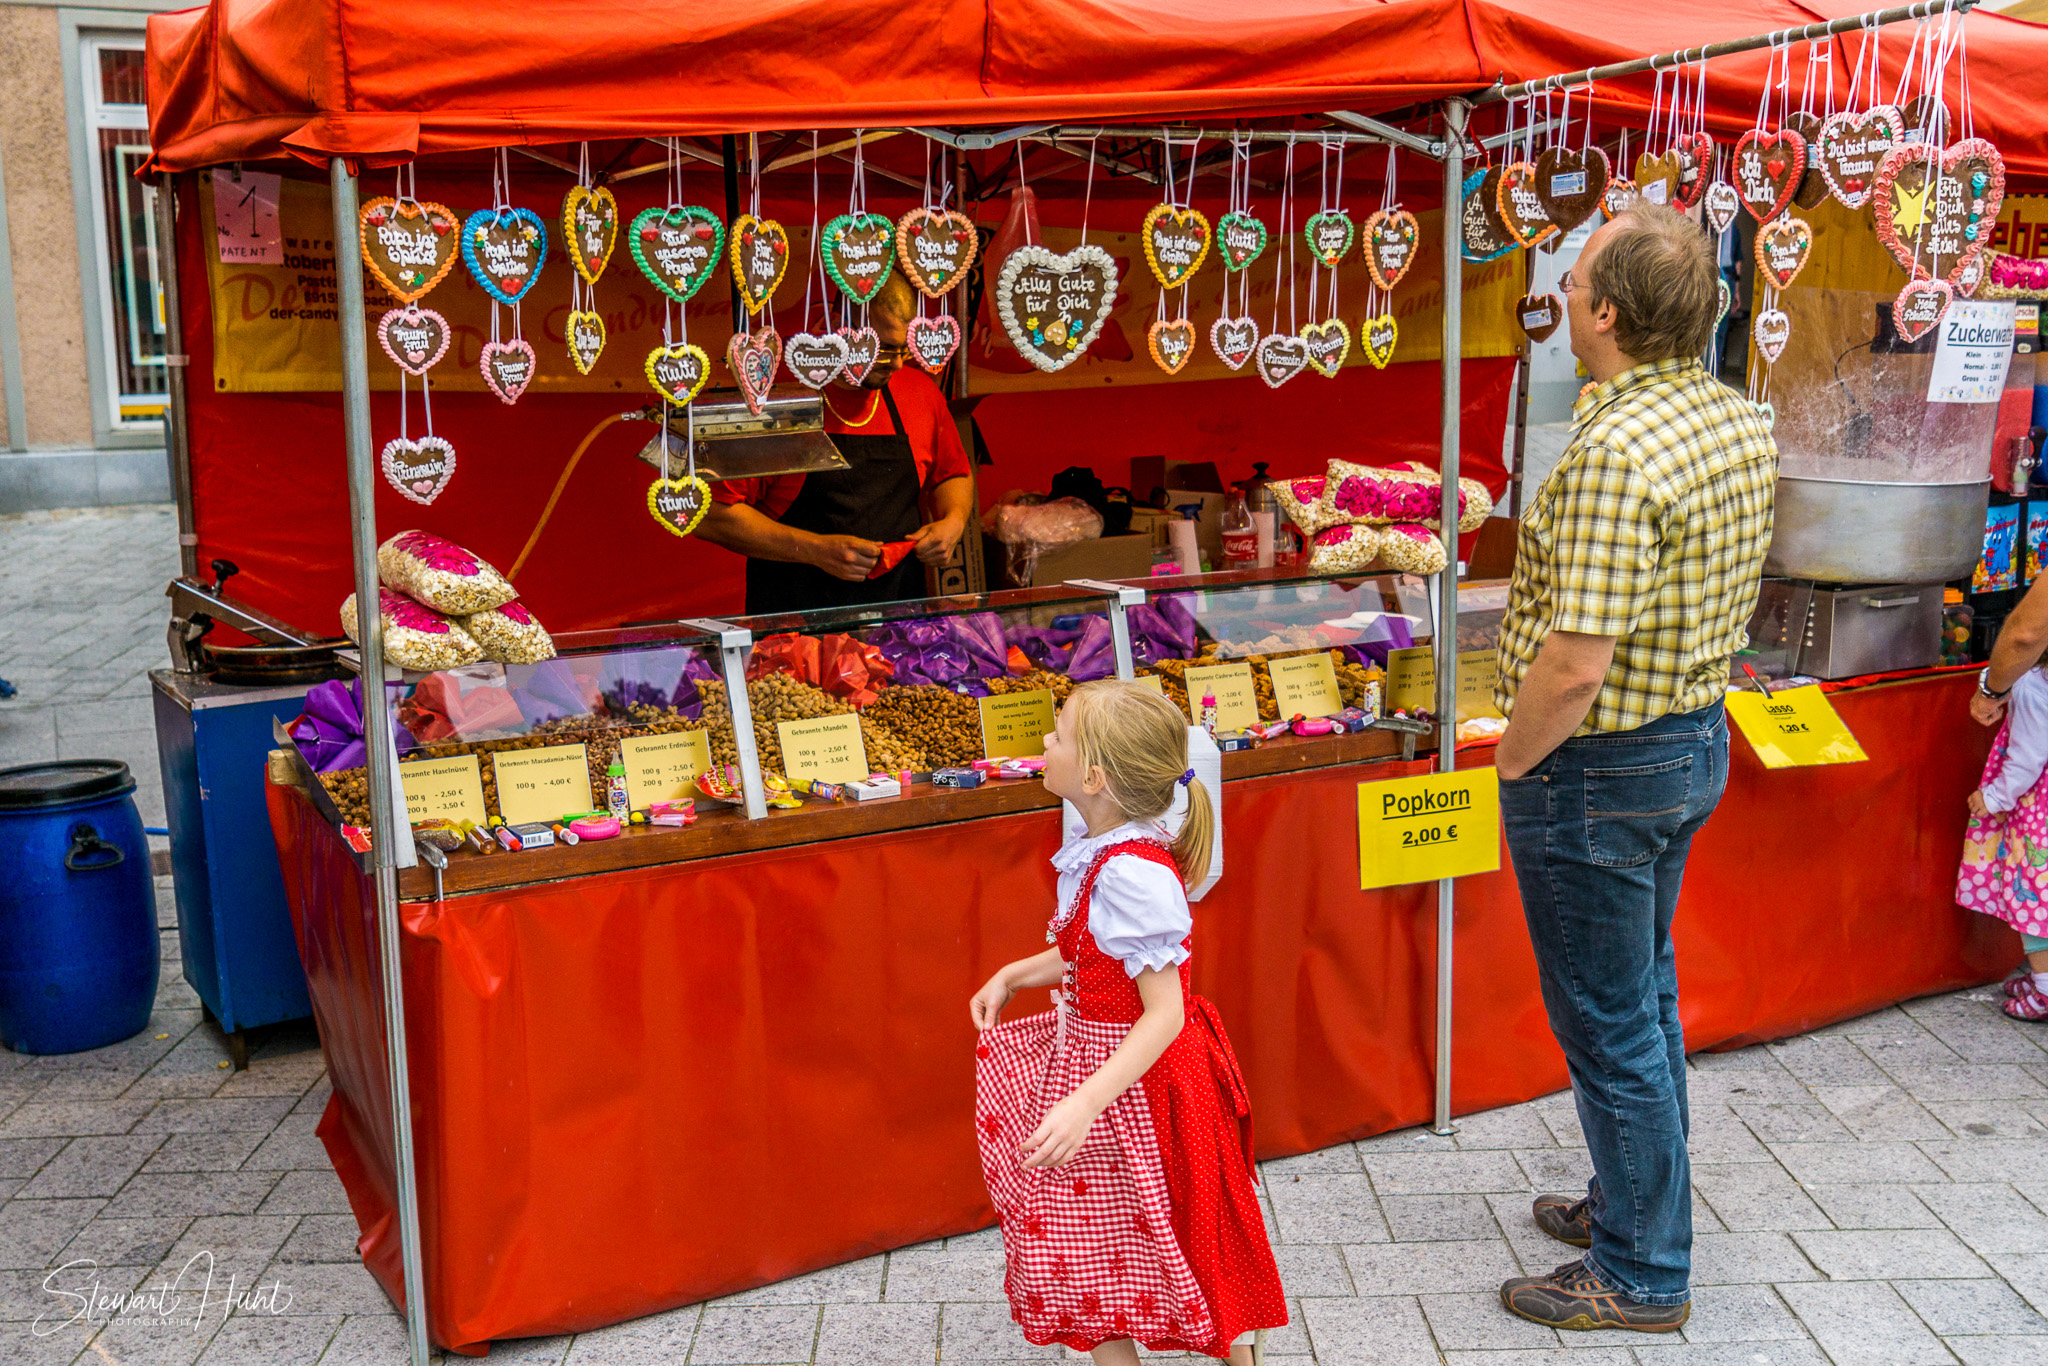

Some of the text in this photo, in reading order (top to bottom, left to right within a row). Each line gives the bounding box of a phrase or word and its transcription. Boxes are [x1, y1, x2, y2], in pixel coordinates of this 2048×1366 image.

[1828, 141, 1845, 158] Du
[1846, 136, 1866, 155] bist
[1867, 136, 1892, 153] mein
[1739, 152, 1761, 179] Ich
[1836, 157, 1874, 176] Traum
[1744, 178, 1776, 205] Dich
[1938, 177, 1963, 197] Für
[1936, 199, 1967, 216] Dich
[1463, 210, 1489, 226] Gut
[377, 226, 413, 250] Papa
[1465, 225, 1487, 239] für
[915, 236, 942, 256] Papa
[1225, 229, 1256, 251] Mutti
[1468, 237, 1497, 251] Dich
[221, 247, 267, 257] PATENT
[482, 241, 511, 261] Papi
[838, 241, 866, 259] Papi
[660, 258, 697, 277] Papi
[752, 256, 775, 280] Papi
[1014, 274, 1096, 294] Alles Gute
[1025, 294, 1091, 313] für Dich
[1914, 297, 1938, 311] Mein
[1947, 322, 2013, 343] Zuckerwatte
[657, 360, 697, 384] Mutti
[657, 492, 698, 513] Mami
[1189, 674, 1214, 683] Gebrannte
[991, 699, 1043, 711] Gebrannte Mandeln
[1227, 701, 1239, 709] 5,00
[1762, 703, 1794, 713] Lasso
[791, 724, 848, 737] Gebrannte Mandeln
[1023, 720, 1037, 728] 2,50
[1778, 723, 1809, 734] 1,20 €
[1024, 730, 1037, 739] 3,50
[635, 740, 696, 753] Gebrannte Erdnüsse
[828, 746, 842, 754] 2,50
[499, 754, 583, 768] Gebrannte Macadamia-Nüsse
[673, 764, 688, 772] 2,50
[800, 761, 812, 769] 200
[830, 757, 844, 765] 3,50
[401, 766, 469, 779] ebrannte Haselnüsse
[675, 775, 690, 784] 3,50
[516, 782, 529, 790] 100
[549, 778, 565, 786] 4,00
[440, 790, 457, 798] 2,50
[458, 788, 464, 796] €
[442, 802, 458, 811] 3,50
[459, 800, 466, 808] €
[1382, 788, 1470, 817] Popkorn
[1402, 825, 1458, 846] 2,00 €
